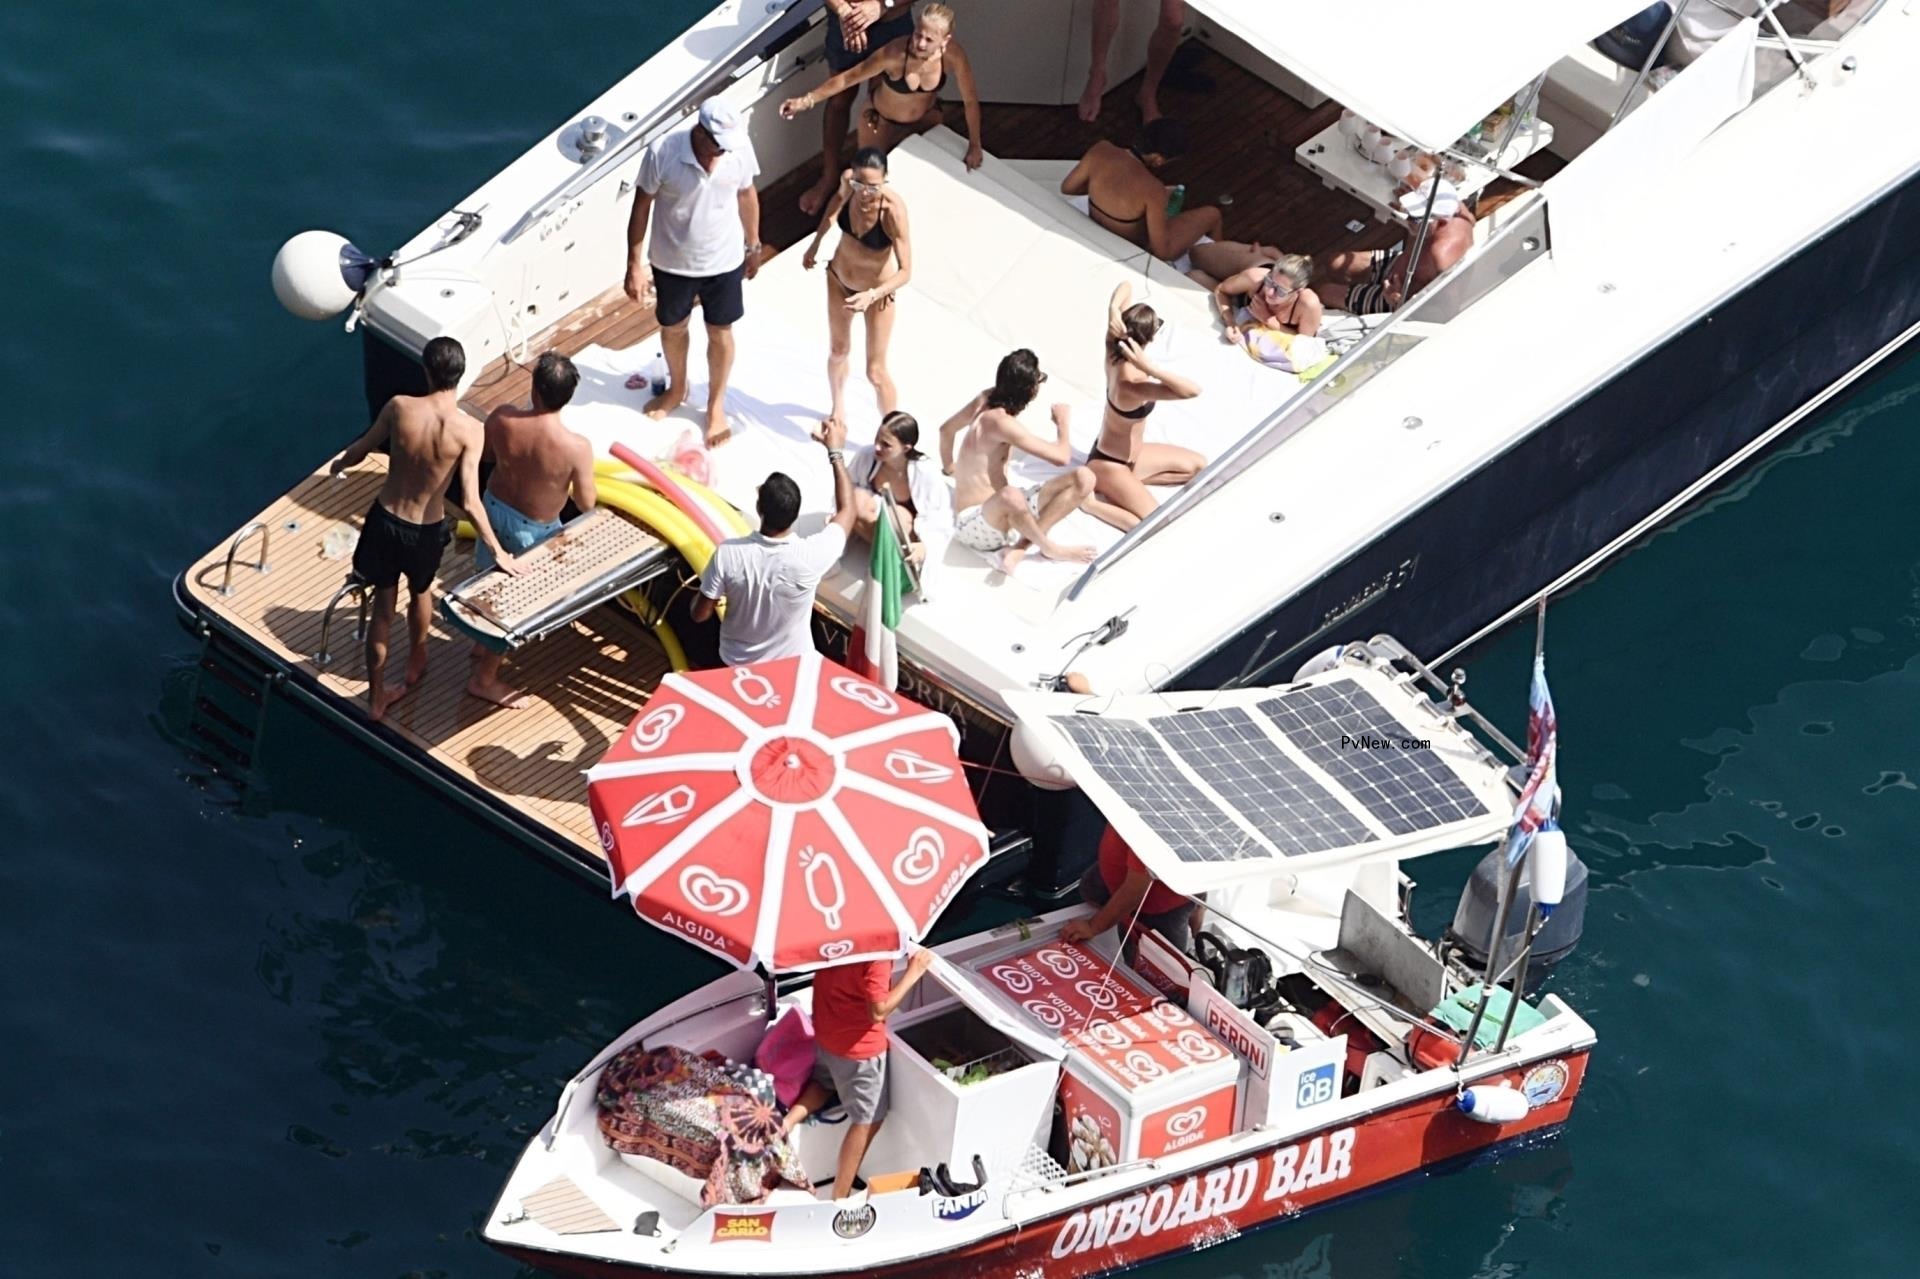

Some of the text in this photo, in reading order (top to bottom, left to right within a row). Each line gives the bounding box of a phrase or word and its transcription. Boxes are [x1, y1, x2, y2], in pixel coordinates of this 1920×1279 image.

[820, 621, 968, 726] VIORIA
[662, 911, 726, 949] ALGIDA
[1061, 942, 1099, 970] ALGIDA
[1017, 958, 1053, 987] ALGIDA
[1047, 992, 1085, 1020] ALGIDA
[1209, 1009, 1266, 1070] PERONI
[1298, 1077, 1332, 1107] QB
[1301, 1072, 1316, 1085] ice
[1163, 1131, 1205, 1153] ALGIDA
[1051, 1127, 1356, 1259] ONBOARD BAR
[716, 1226, 769, 1238] CARLO
[727, 1217, 760, 1228] SAN
